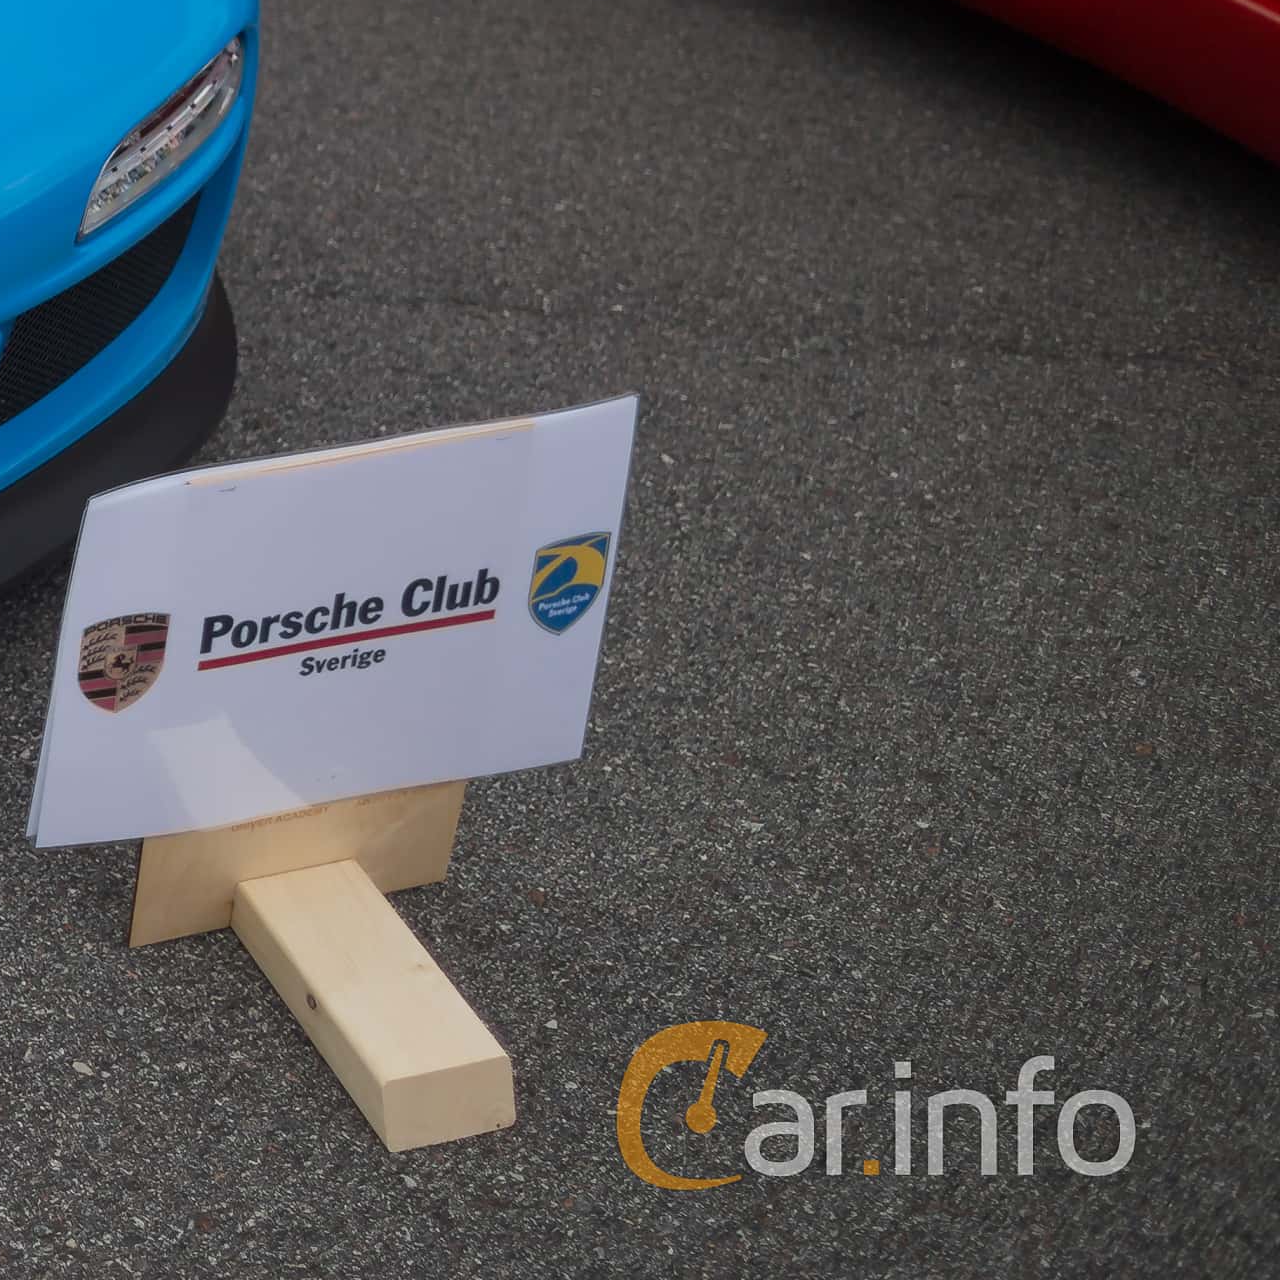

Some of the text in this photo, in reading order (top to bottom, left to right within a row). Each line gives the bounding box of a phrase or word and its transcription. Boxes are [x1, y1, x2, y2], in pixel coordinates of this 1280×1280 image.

[83, 612, 170, 638] PORSCHE
[198, 567, 501, 655] Porsche Club
[298, 645, 386, 677] Sverige
